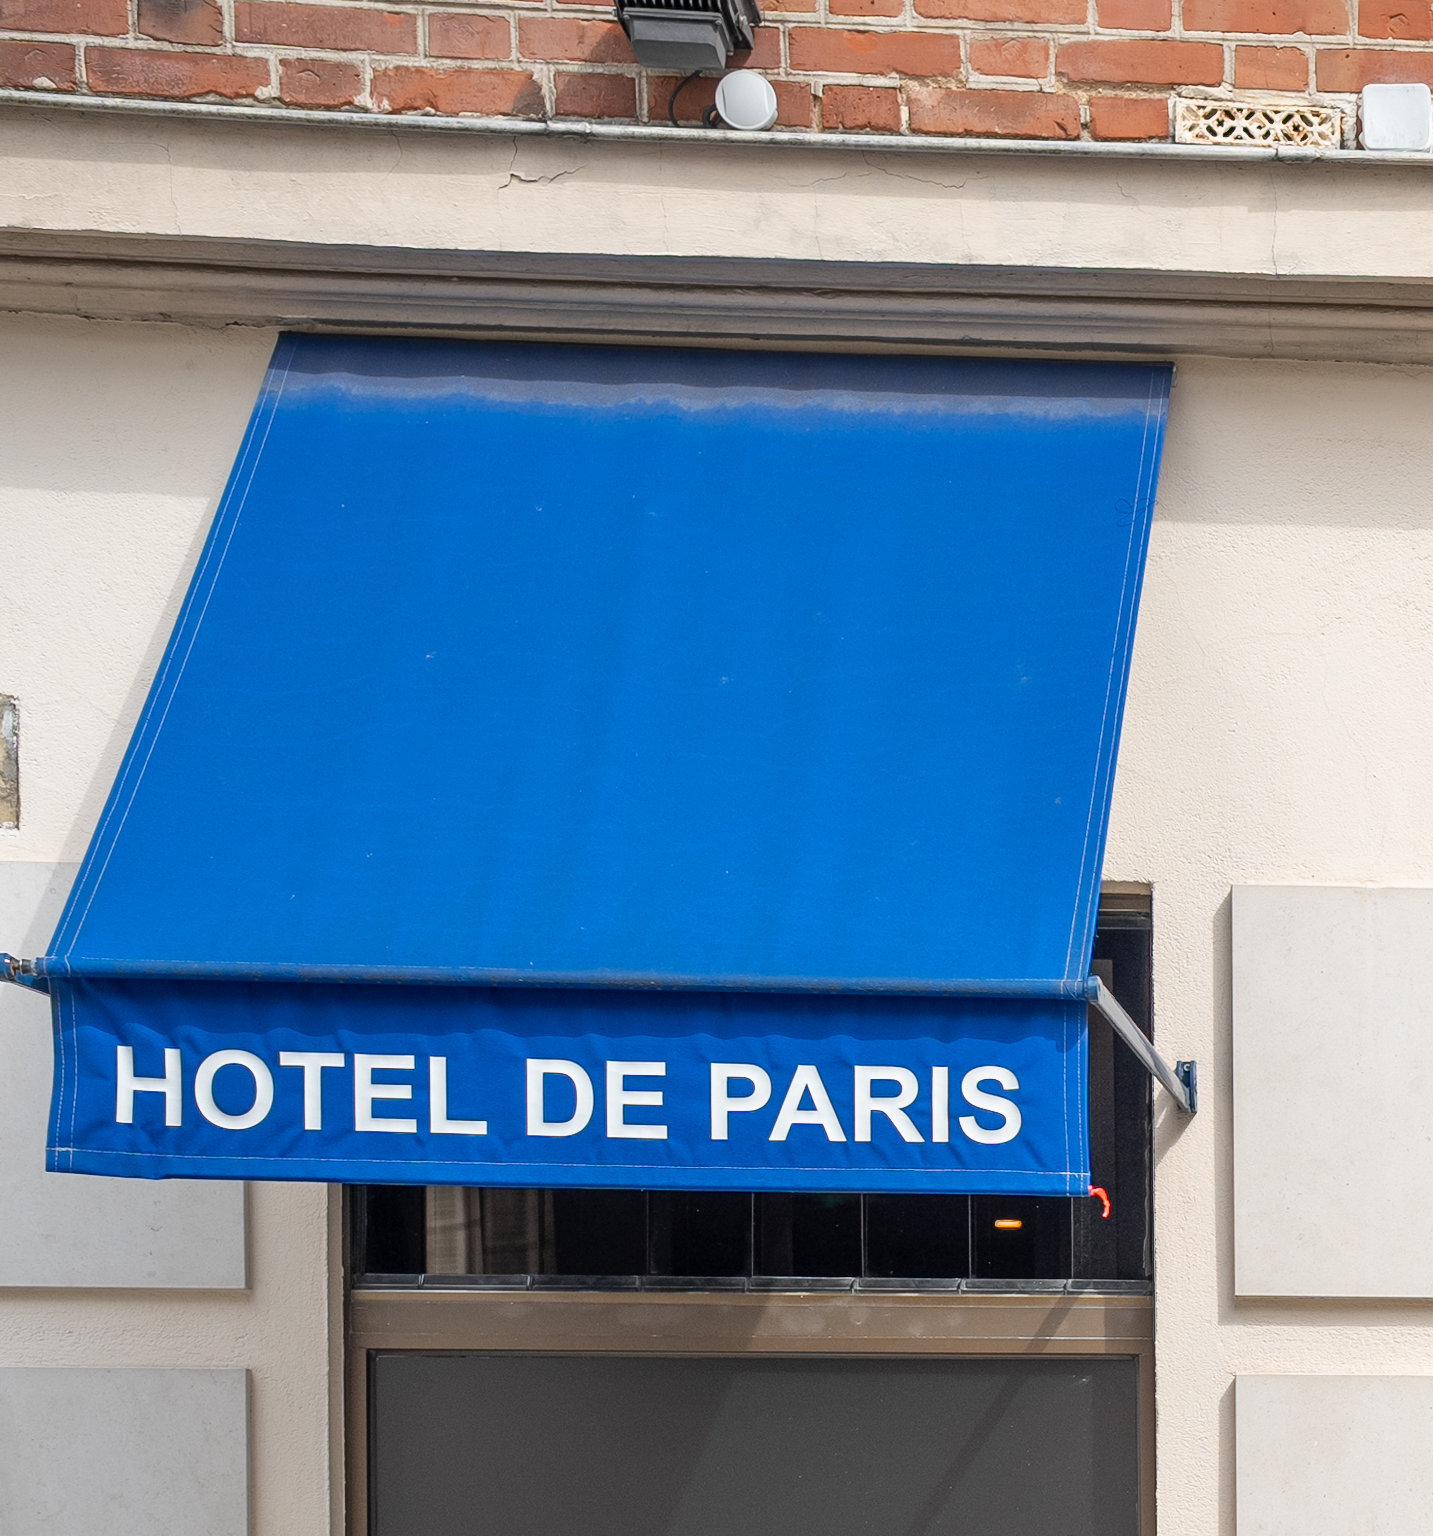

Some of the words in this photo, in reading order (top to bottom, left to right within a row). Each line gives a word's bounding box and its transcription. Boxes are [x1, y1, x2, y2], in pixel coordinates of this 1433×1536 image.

[115, 1045, 488, 1136] HOTEL
[526, 1058, 669, 1140] DE
[710, 1062, 1023, 1145] PARIS
